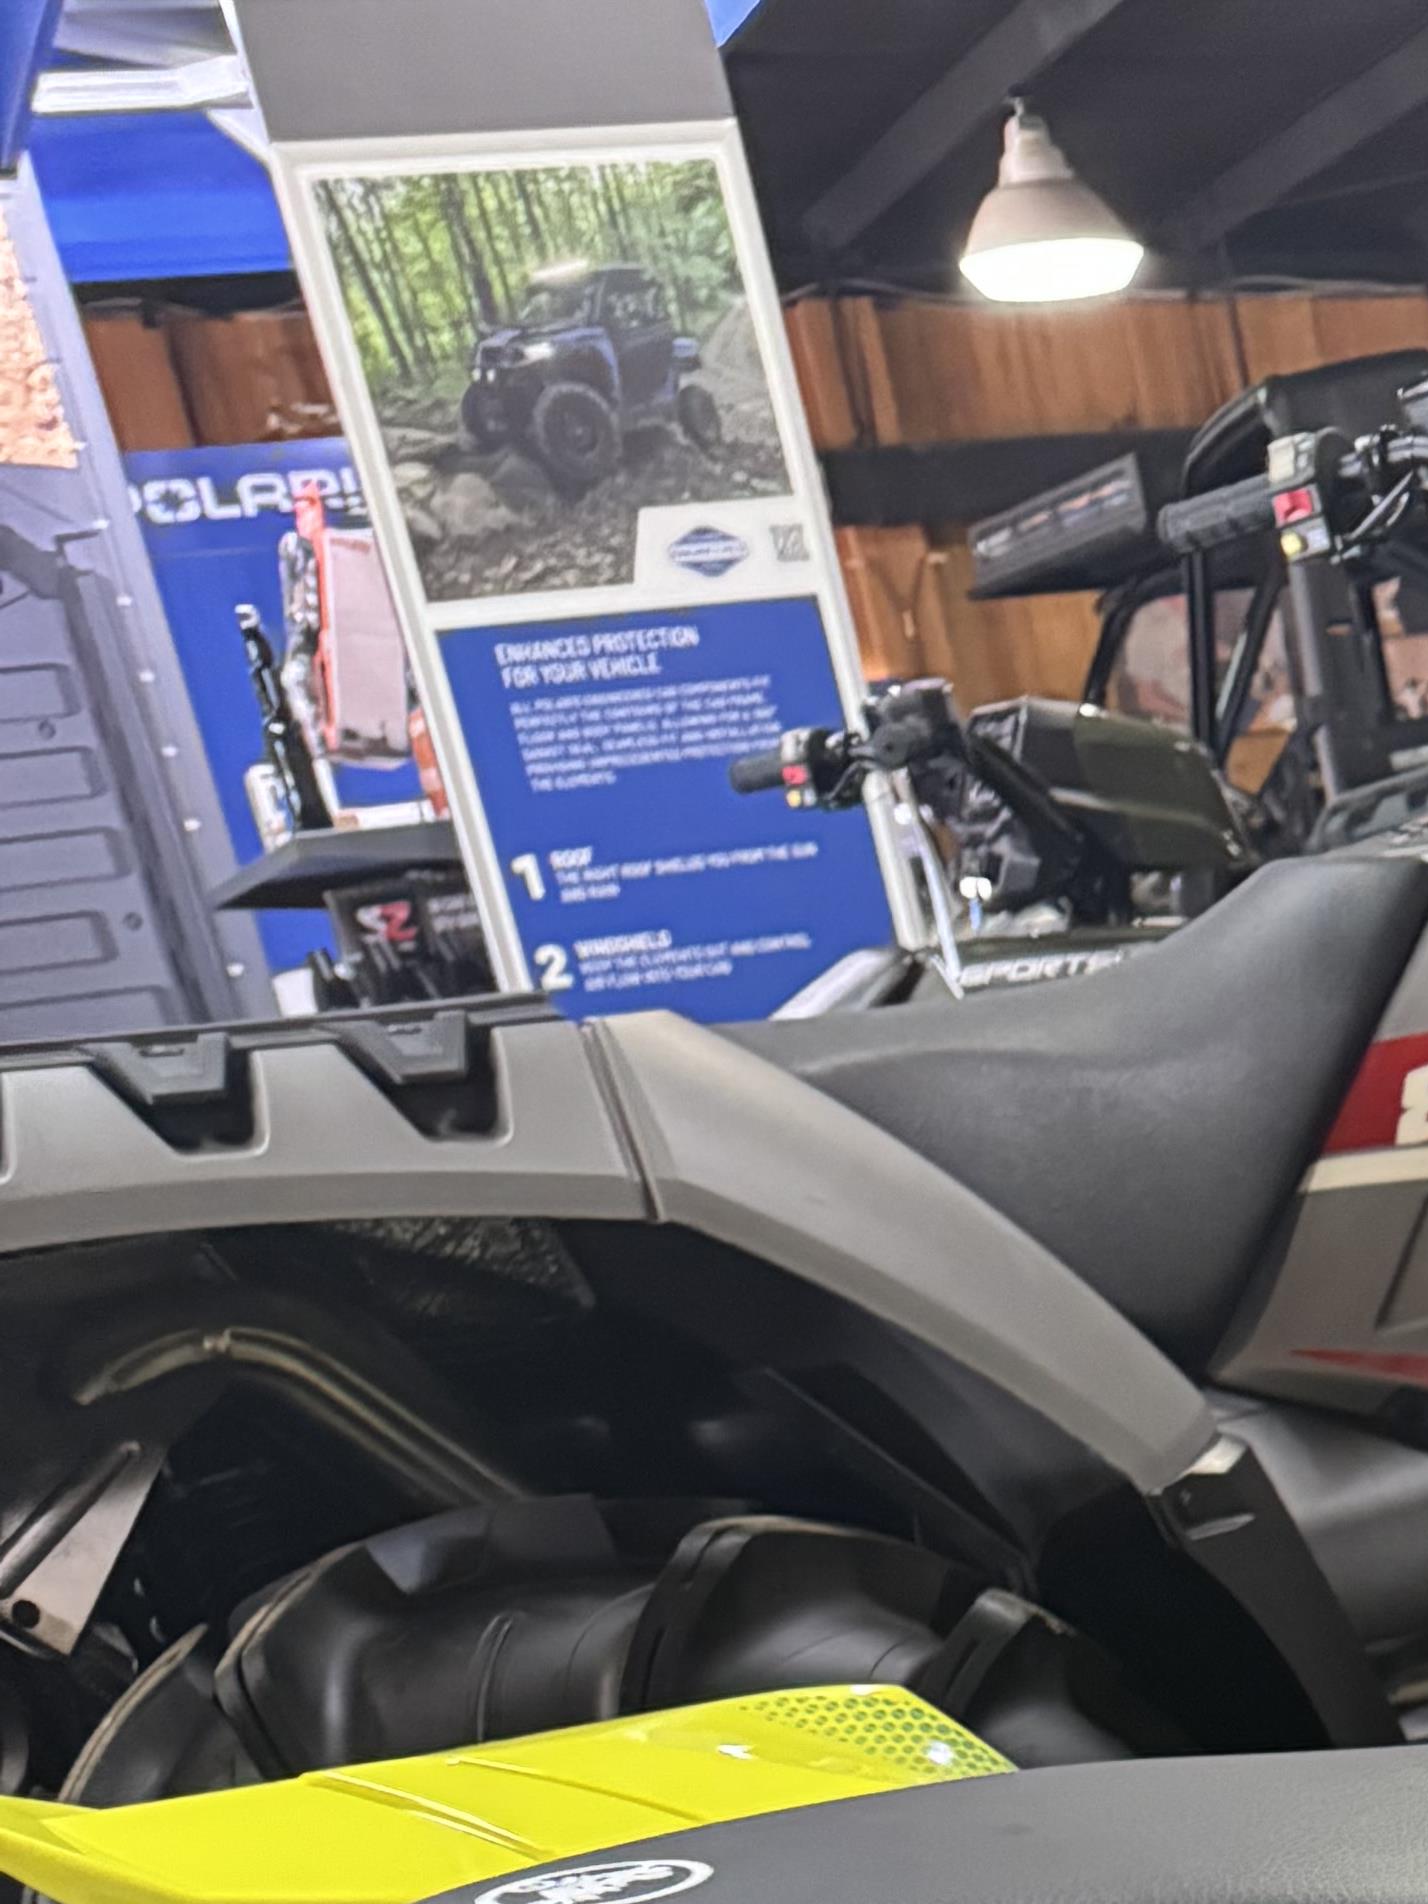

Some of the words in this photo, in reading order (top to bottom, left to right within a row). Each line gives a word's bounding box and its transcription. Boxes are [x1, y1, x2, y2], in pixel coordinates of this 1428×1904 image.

[128, 467, 368, 524] OLARI
[494, 635, 591, 666] ENHANCED
[592, 625, 700, 654] PROTECTION
[501, 665, 539, 689] FOR
[540, 660, 587, 685] YOUR
[588, 651, 662, 680] VEHICLE
[510, 853, 546, 900] 1
[533, 943, 574, 990] 2
[959, 949, 1125, 987] SPORTS
